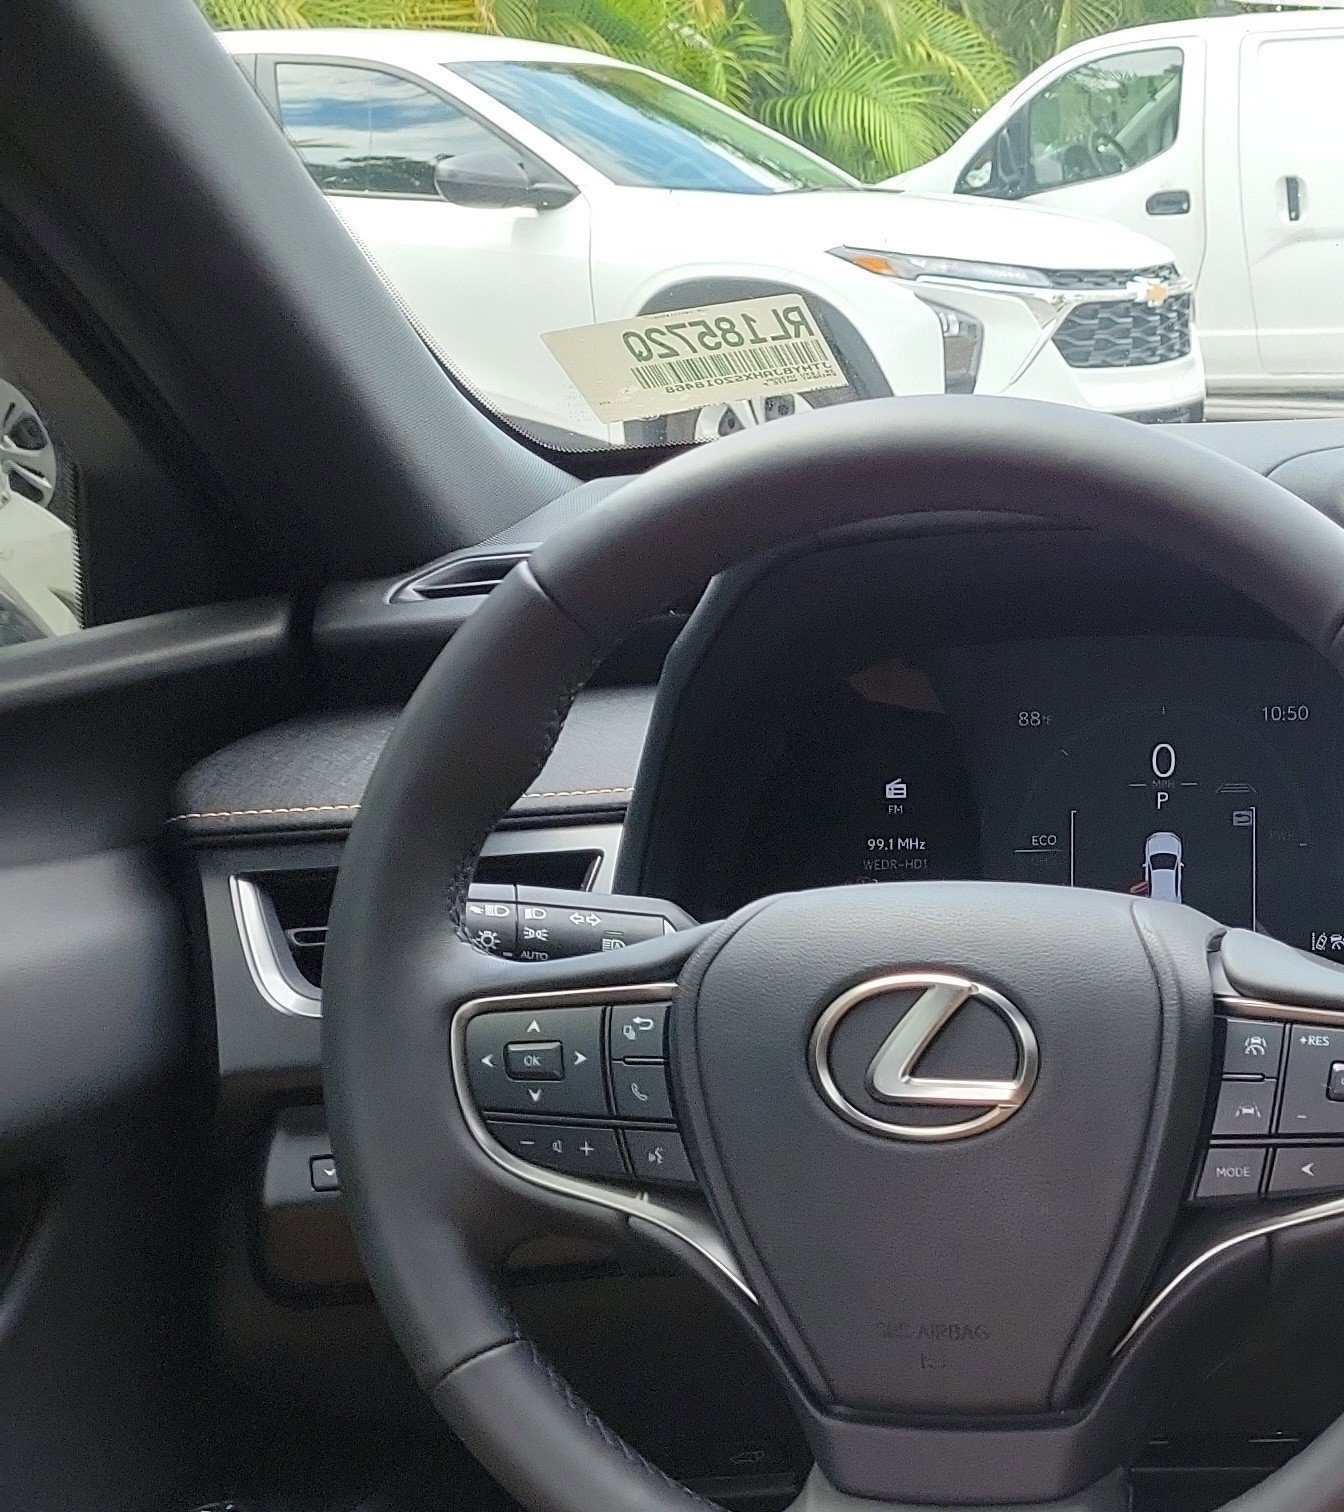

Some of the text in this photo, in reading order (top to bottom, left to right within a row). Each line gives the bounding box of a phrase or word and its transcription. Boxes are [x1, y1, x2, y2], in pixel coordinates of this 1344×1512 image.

[1261, 705, 1309, 722] 10:50
[1151, 743, 1176, 778] 0
[1157, 792, 1169, 810] P
[888, 804, 903, 815] FM
[867, 837, 926, 851] 99.1 MHz
[1031, 834, 1057, 846] ECO
[520, 950, 549, 961] AUTO
[523, 1055, 541, 1067] OK
[1216, 1166, 1251, 1178] MODE
